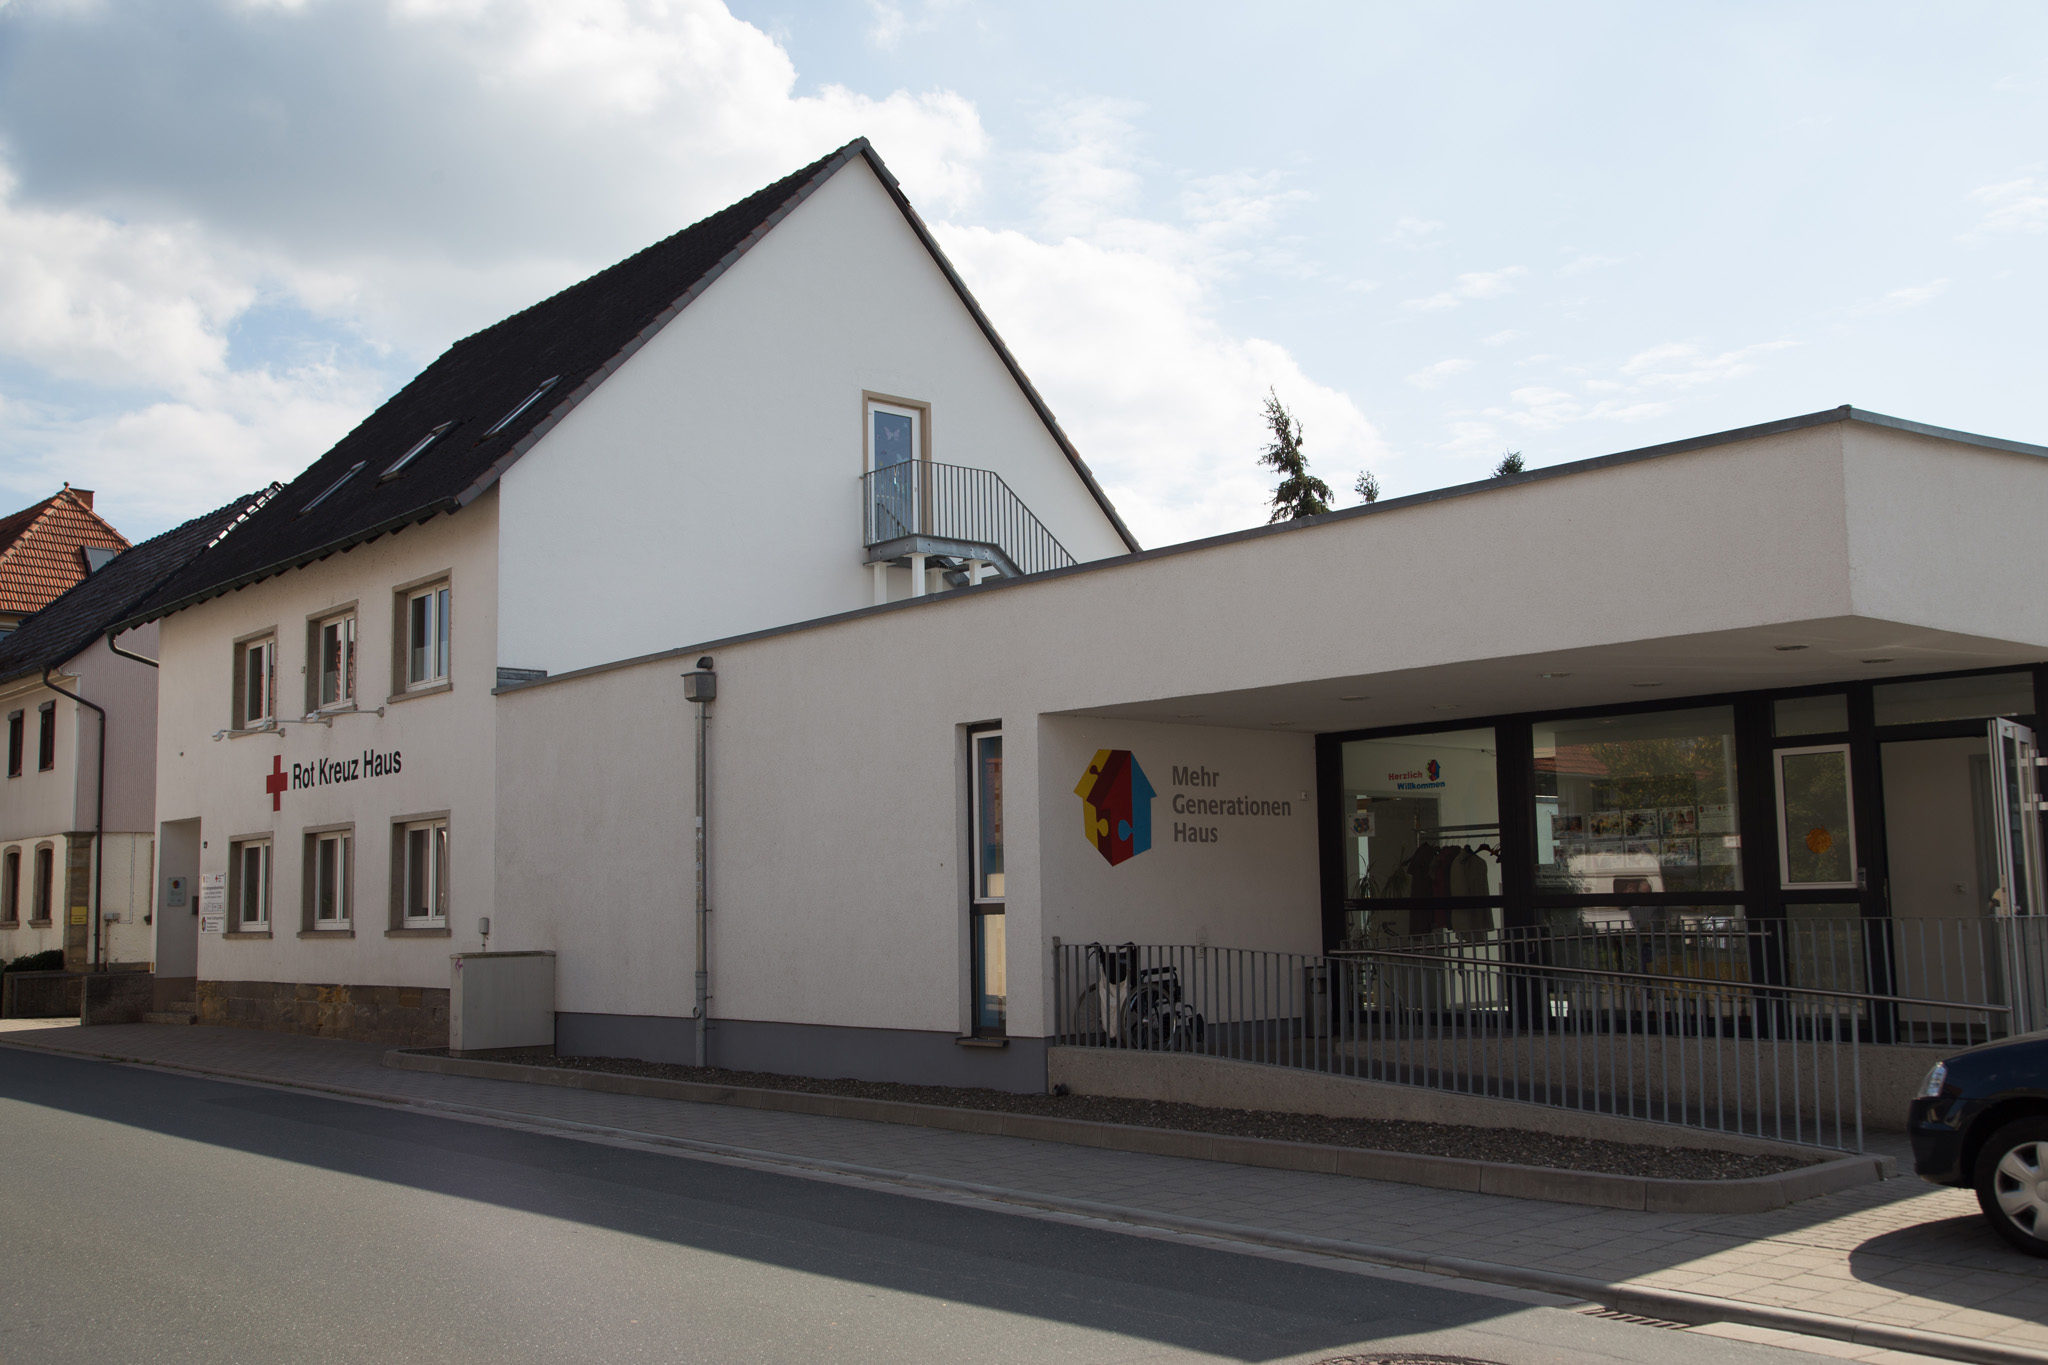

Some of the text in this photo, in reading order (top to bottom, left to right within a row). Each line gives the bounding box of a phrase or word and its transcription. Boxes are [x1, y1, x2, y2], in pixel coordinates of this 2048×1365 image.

[293, 749, 402, 790] Rot Kreuz Haus
[1172, 765, 1220, 787] Mehr
[1388, 771, 1423, 781] Herzlich
[1397, 781, 1445, 790] Willkommen
[1172, 794, 1291, 816] Generationen
[1173, 822, 1218, 843] Haus
